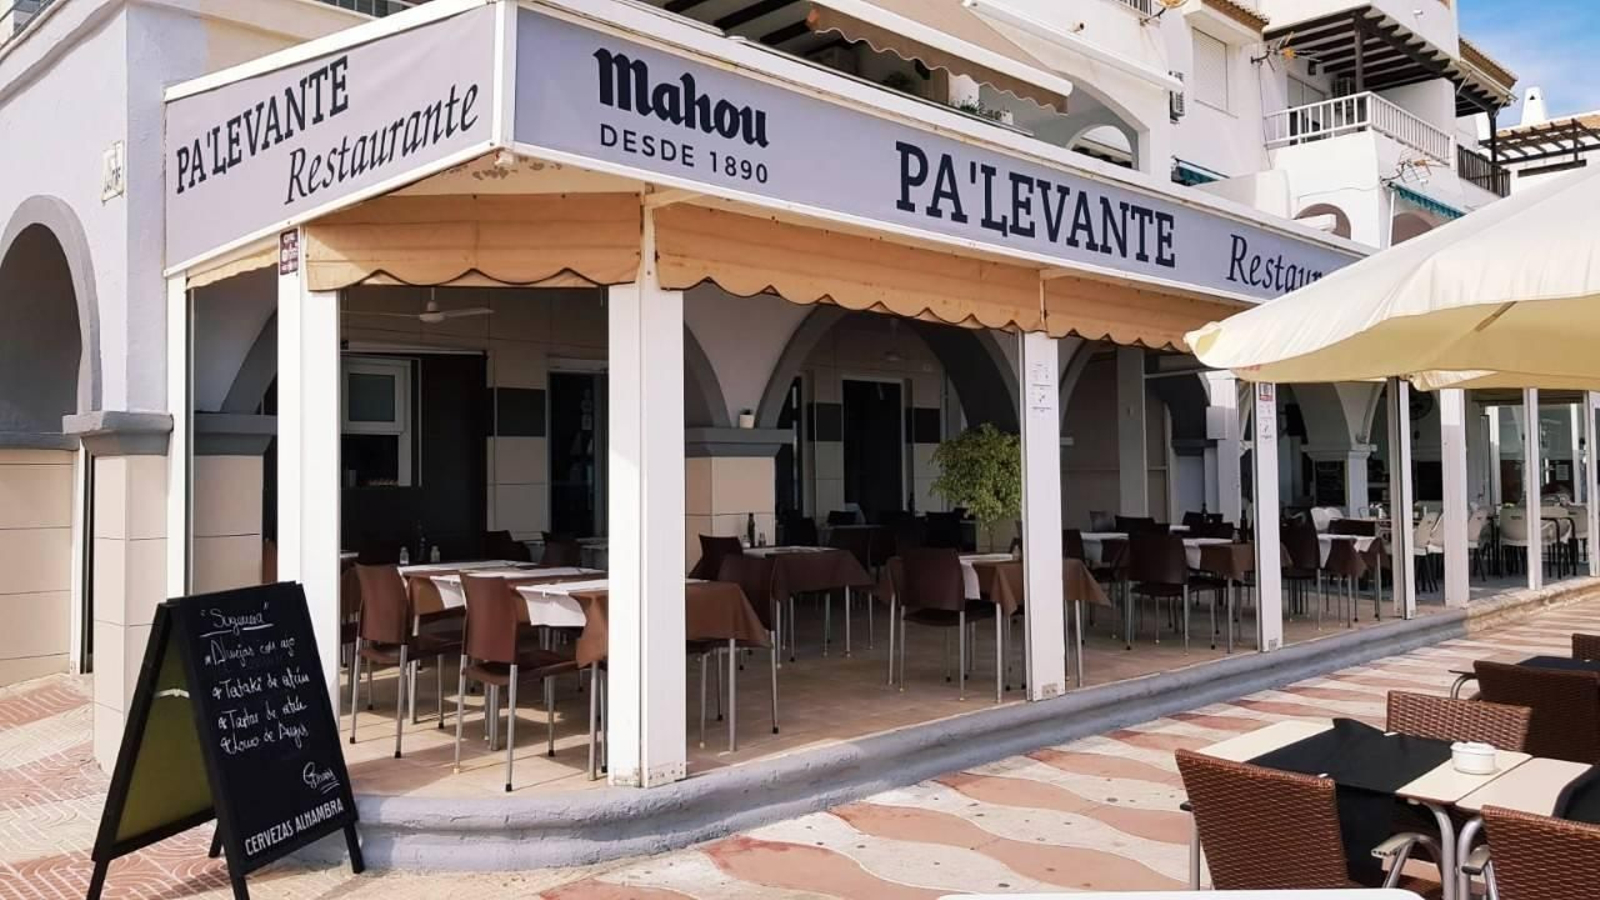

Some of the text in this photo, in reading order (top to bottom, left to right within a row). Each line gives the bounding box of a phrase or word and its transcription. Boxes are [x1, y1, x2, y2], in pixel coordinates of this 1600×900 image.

[176, 55, 349, 194] PA'LEVANTE
[284, 84, 479, 205] Restaurante
[592, 48, 770, 149] Mahou
[600, 123, 769, 184] DESDE 1890
[895, 140, 1176, 268] PA'LEVANTE
[244, 798, 344, 856] CERVEZAS ALHAMBRA
